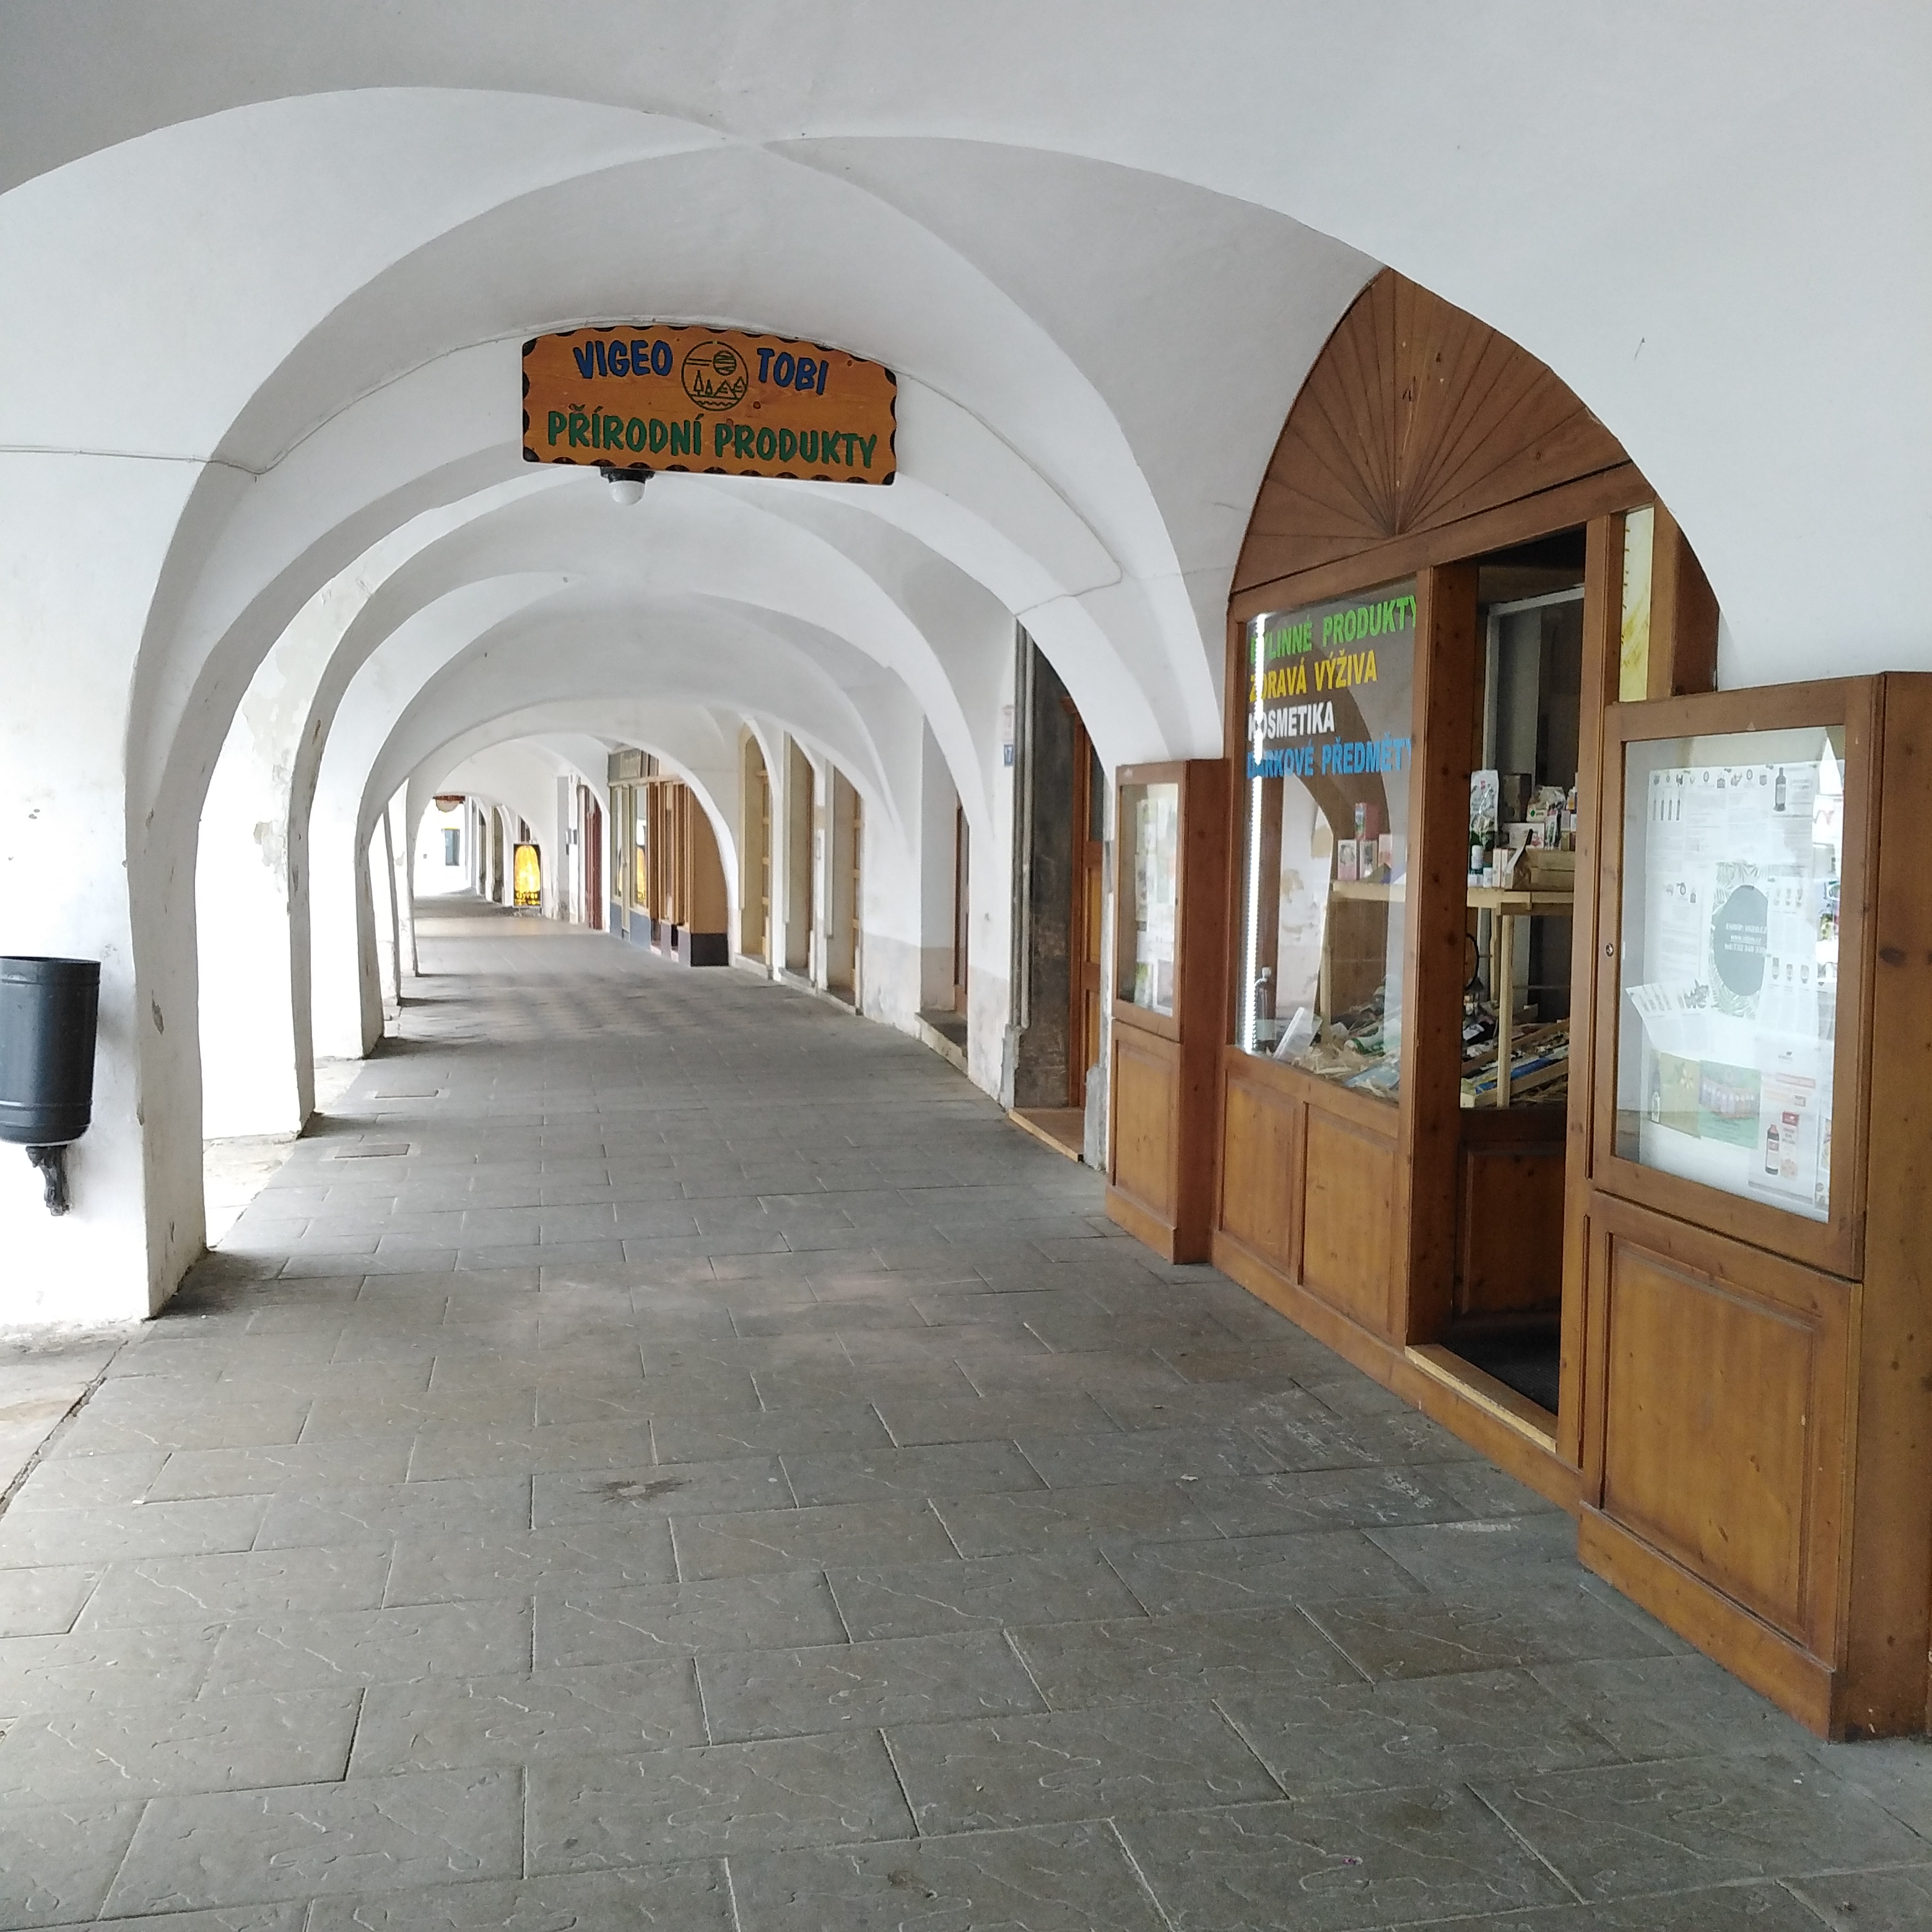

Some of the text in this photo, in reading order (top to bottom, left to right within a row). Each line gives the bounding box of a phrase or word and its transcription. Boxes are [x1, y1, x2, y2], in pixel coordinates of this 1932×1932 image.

[573, 340, 829, 395] VIGEO TOBI
[548, 403, 877, 468] PŘÍRODNÍ PRODUKTY
[1315, 648, 1377, 692] VÝŽIVA
[1248, 700, 1335, 742] KOSMETIKA
